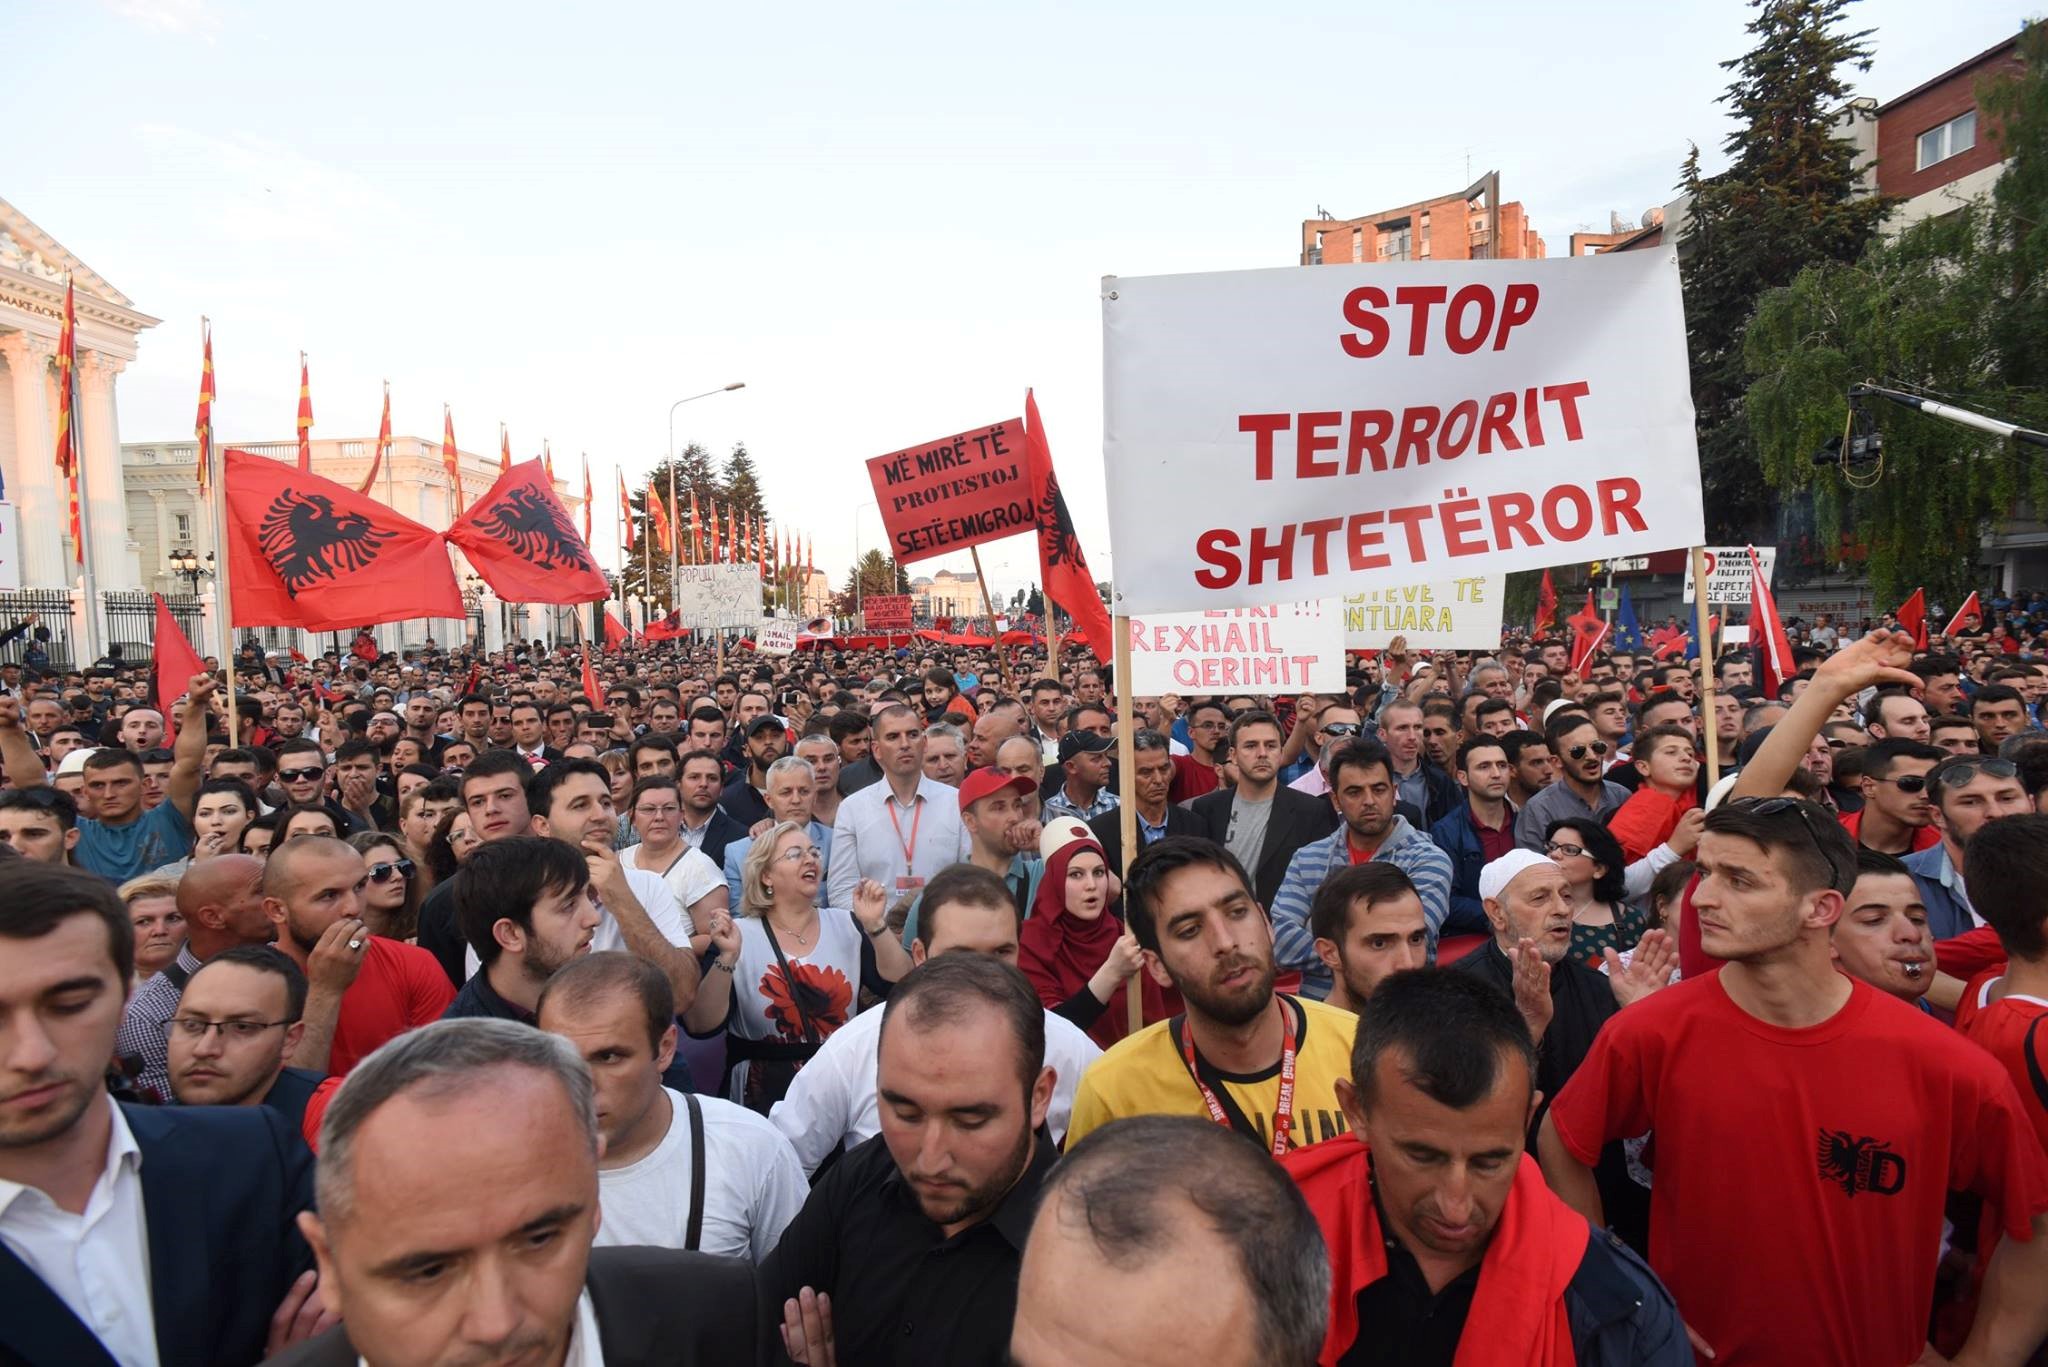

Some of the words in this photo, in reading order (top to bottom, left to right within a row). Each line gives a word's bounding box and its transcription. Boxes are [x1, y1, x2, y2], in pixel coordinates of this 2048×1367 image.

[1340, 283, 1539, 359] STOP
[1238, 381, 1590, 481] TERRORIT
[882, 453, 915, 486] MË
[916, 436, 971, 476] MIRË
[972, 425, 1010, 460] TË
[893, 464, 1019, 513] PROTESTOJ
[1194, 476, 1648, 590] SHTETËROR
[764, 630, 791, 641] ISMAIL
[1129, 619, 1284, 653] REXHAIL
[1344, 605, 1453, 633] NTUARA
[1173, 655, 1319, 688] QERIMIT
[1282, 1049, 1296, 1080] DOWN
[1278, 1083, 1293, 1116] BREAK
